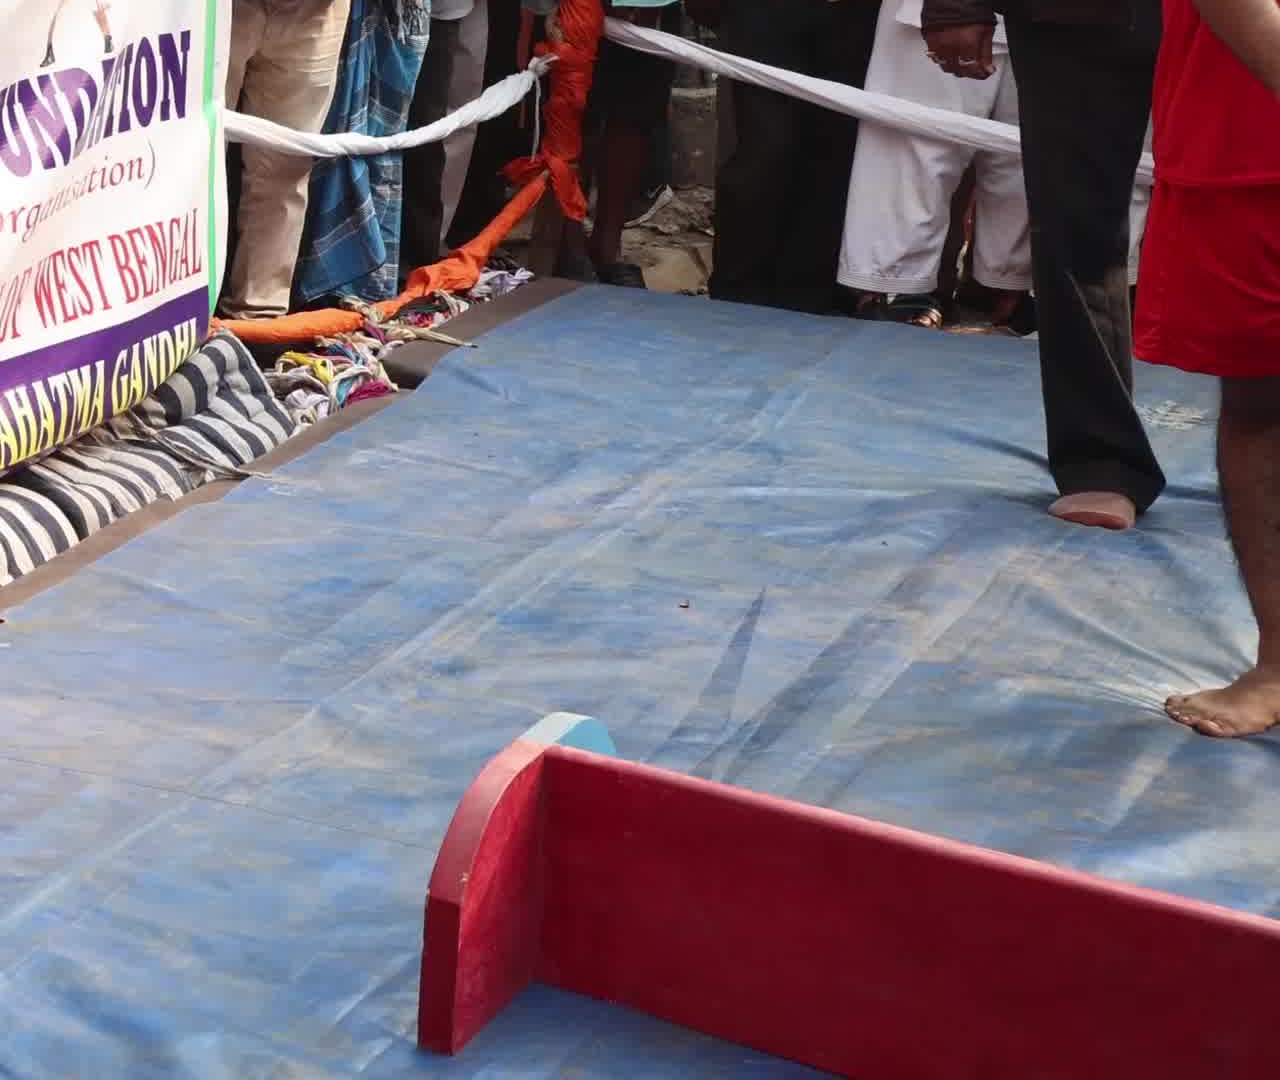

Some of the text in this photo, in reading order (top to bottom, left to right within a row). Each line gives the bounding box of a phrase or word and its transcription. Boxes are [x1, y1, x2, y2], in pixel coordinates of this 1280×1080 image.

[33, 239, 113, 330] WEST
[108, 207, 202, 305] BENGAL
[111, 317, 198, 413] GANDHI
